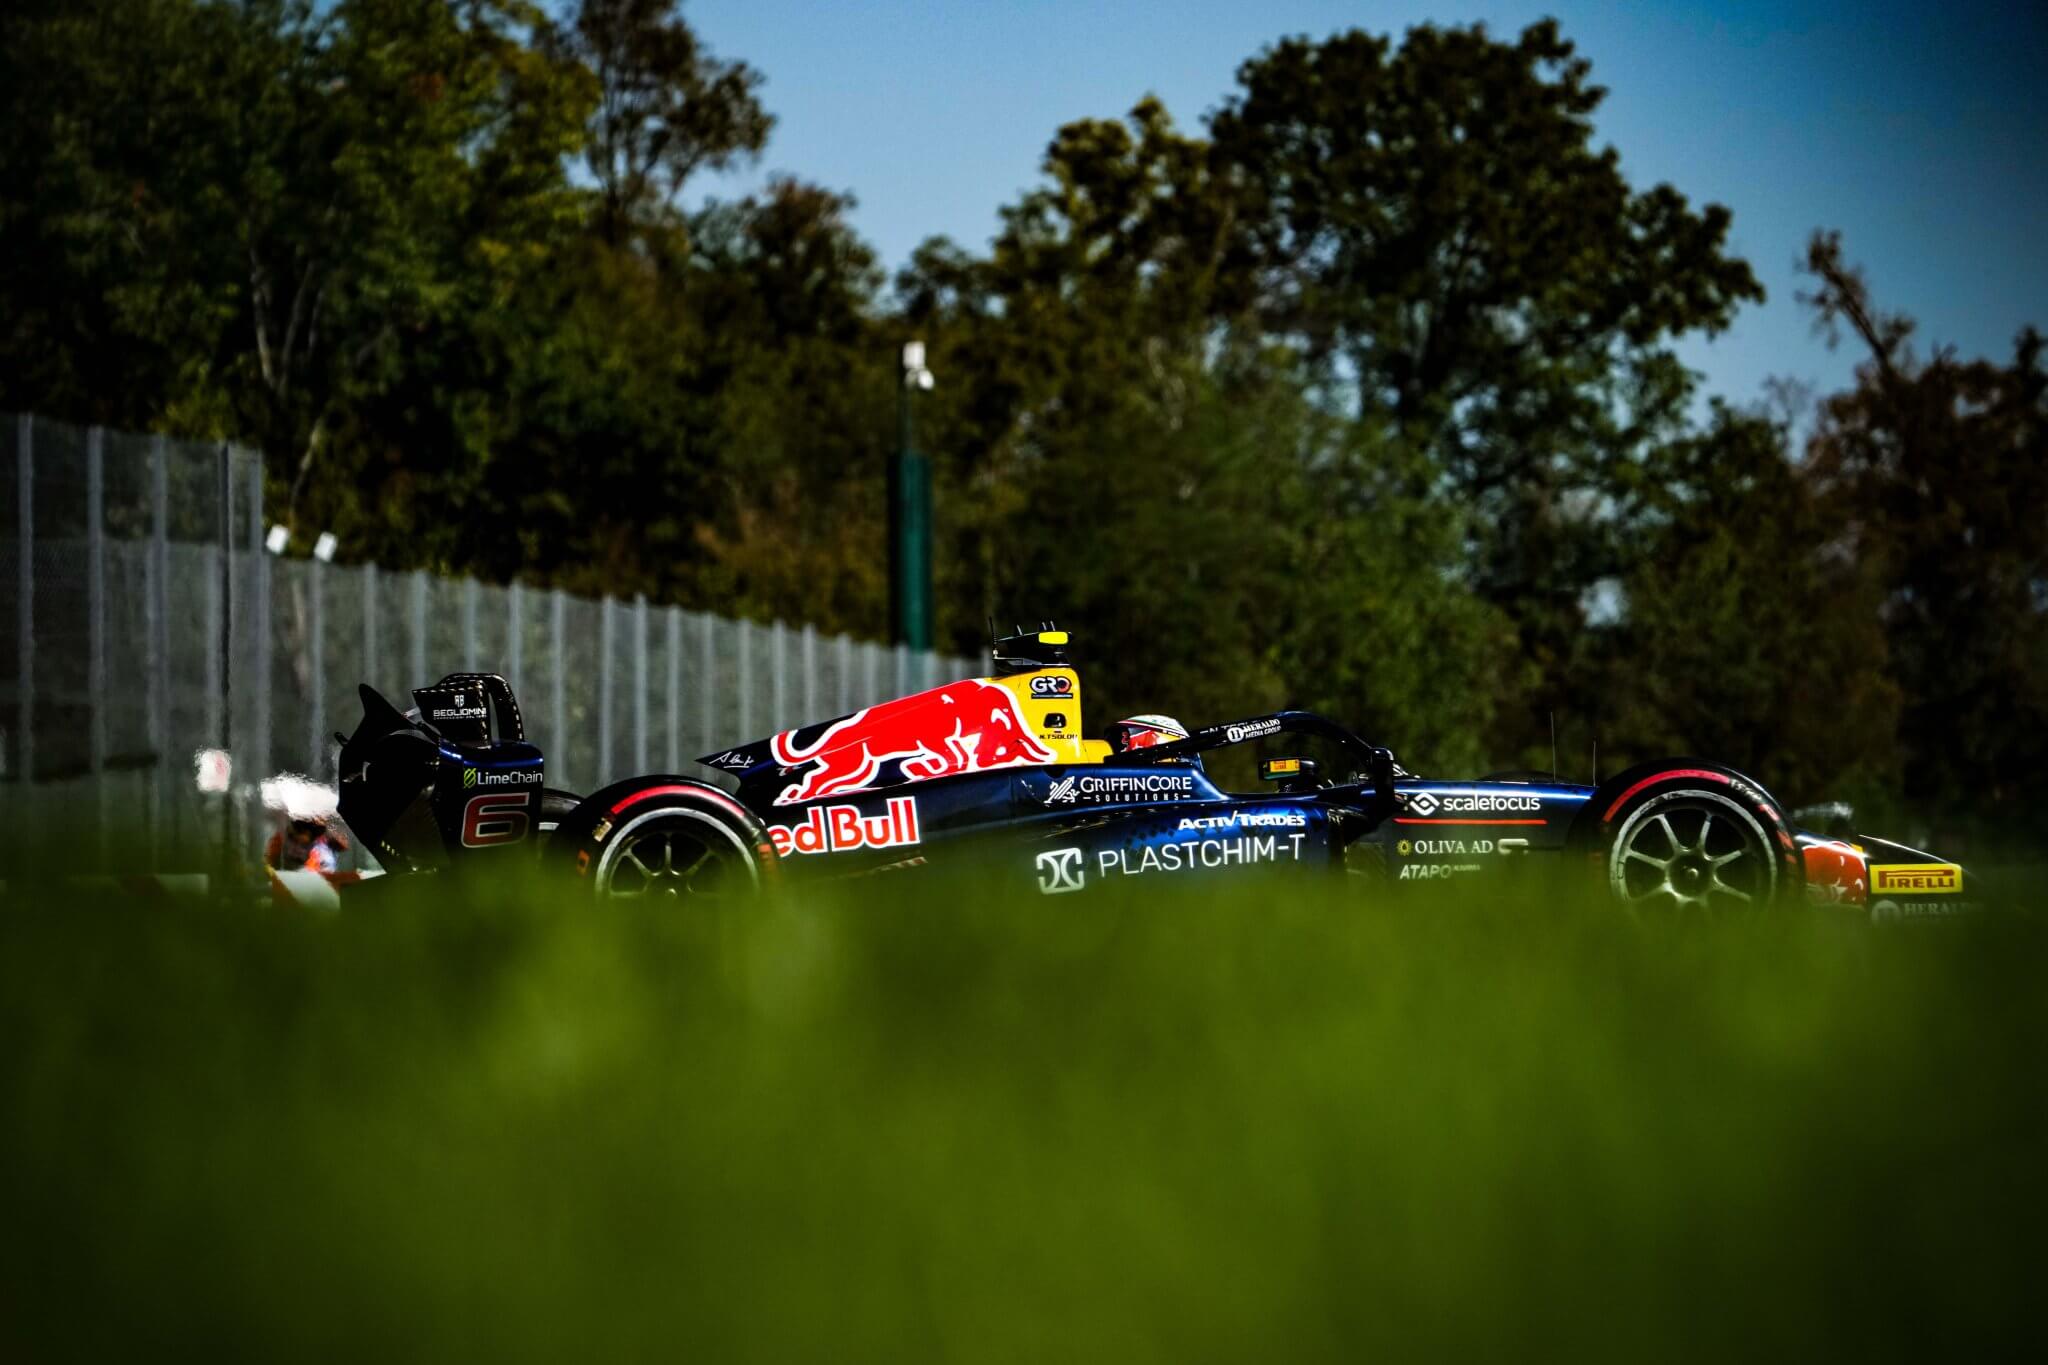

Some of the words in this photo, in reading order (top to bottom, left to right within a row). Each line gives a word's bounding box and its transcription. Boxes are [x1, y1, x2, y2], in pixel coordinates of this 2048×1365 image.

[433, 707, 487, 717] BEGLIOMINI
[477, 770, 544, 785] LimeChain
[1095, 793, 1179, 803] SOLUTIONS
[1443, 794, 1541, 811] scalefocus
[461, 792, 531, 849] 6
[767, 806, 828, 857] ed
[827, 796, 921, 851] Bull
[1099, 834, 1305, 877] PLASTCHIM-T
[1414, 840, 1466, 854] OLIVA
[1470, 840, 1494, 854] AD
[1879, 869, 1955, 888] PIRELLI
